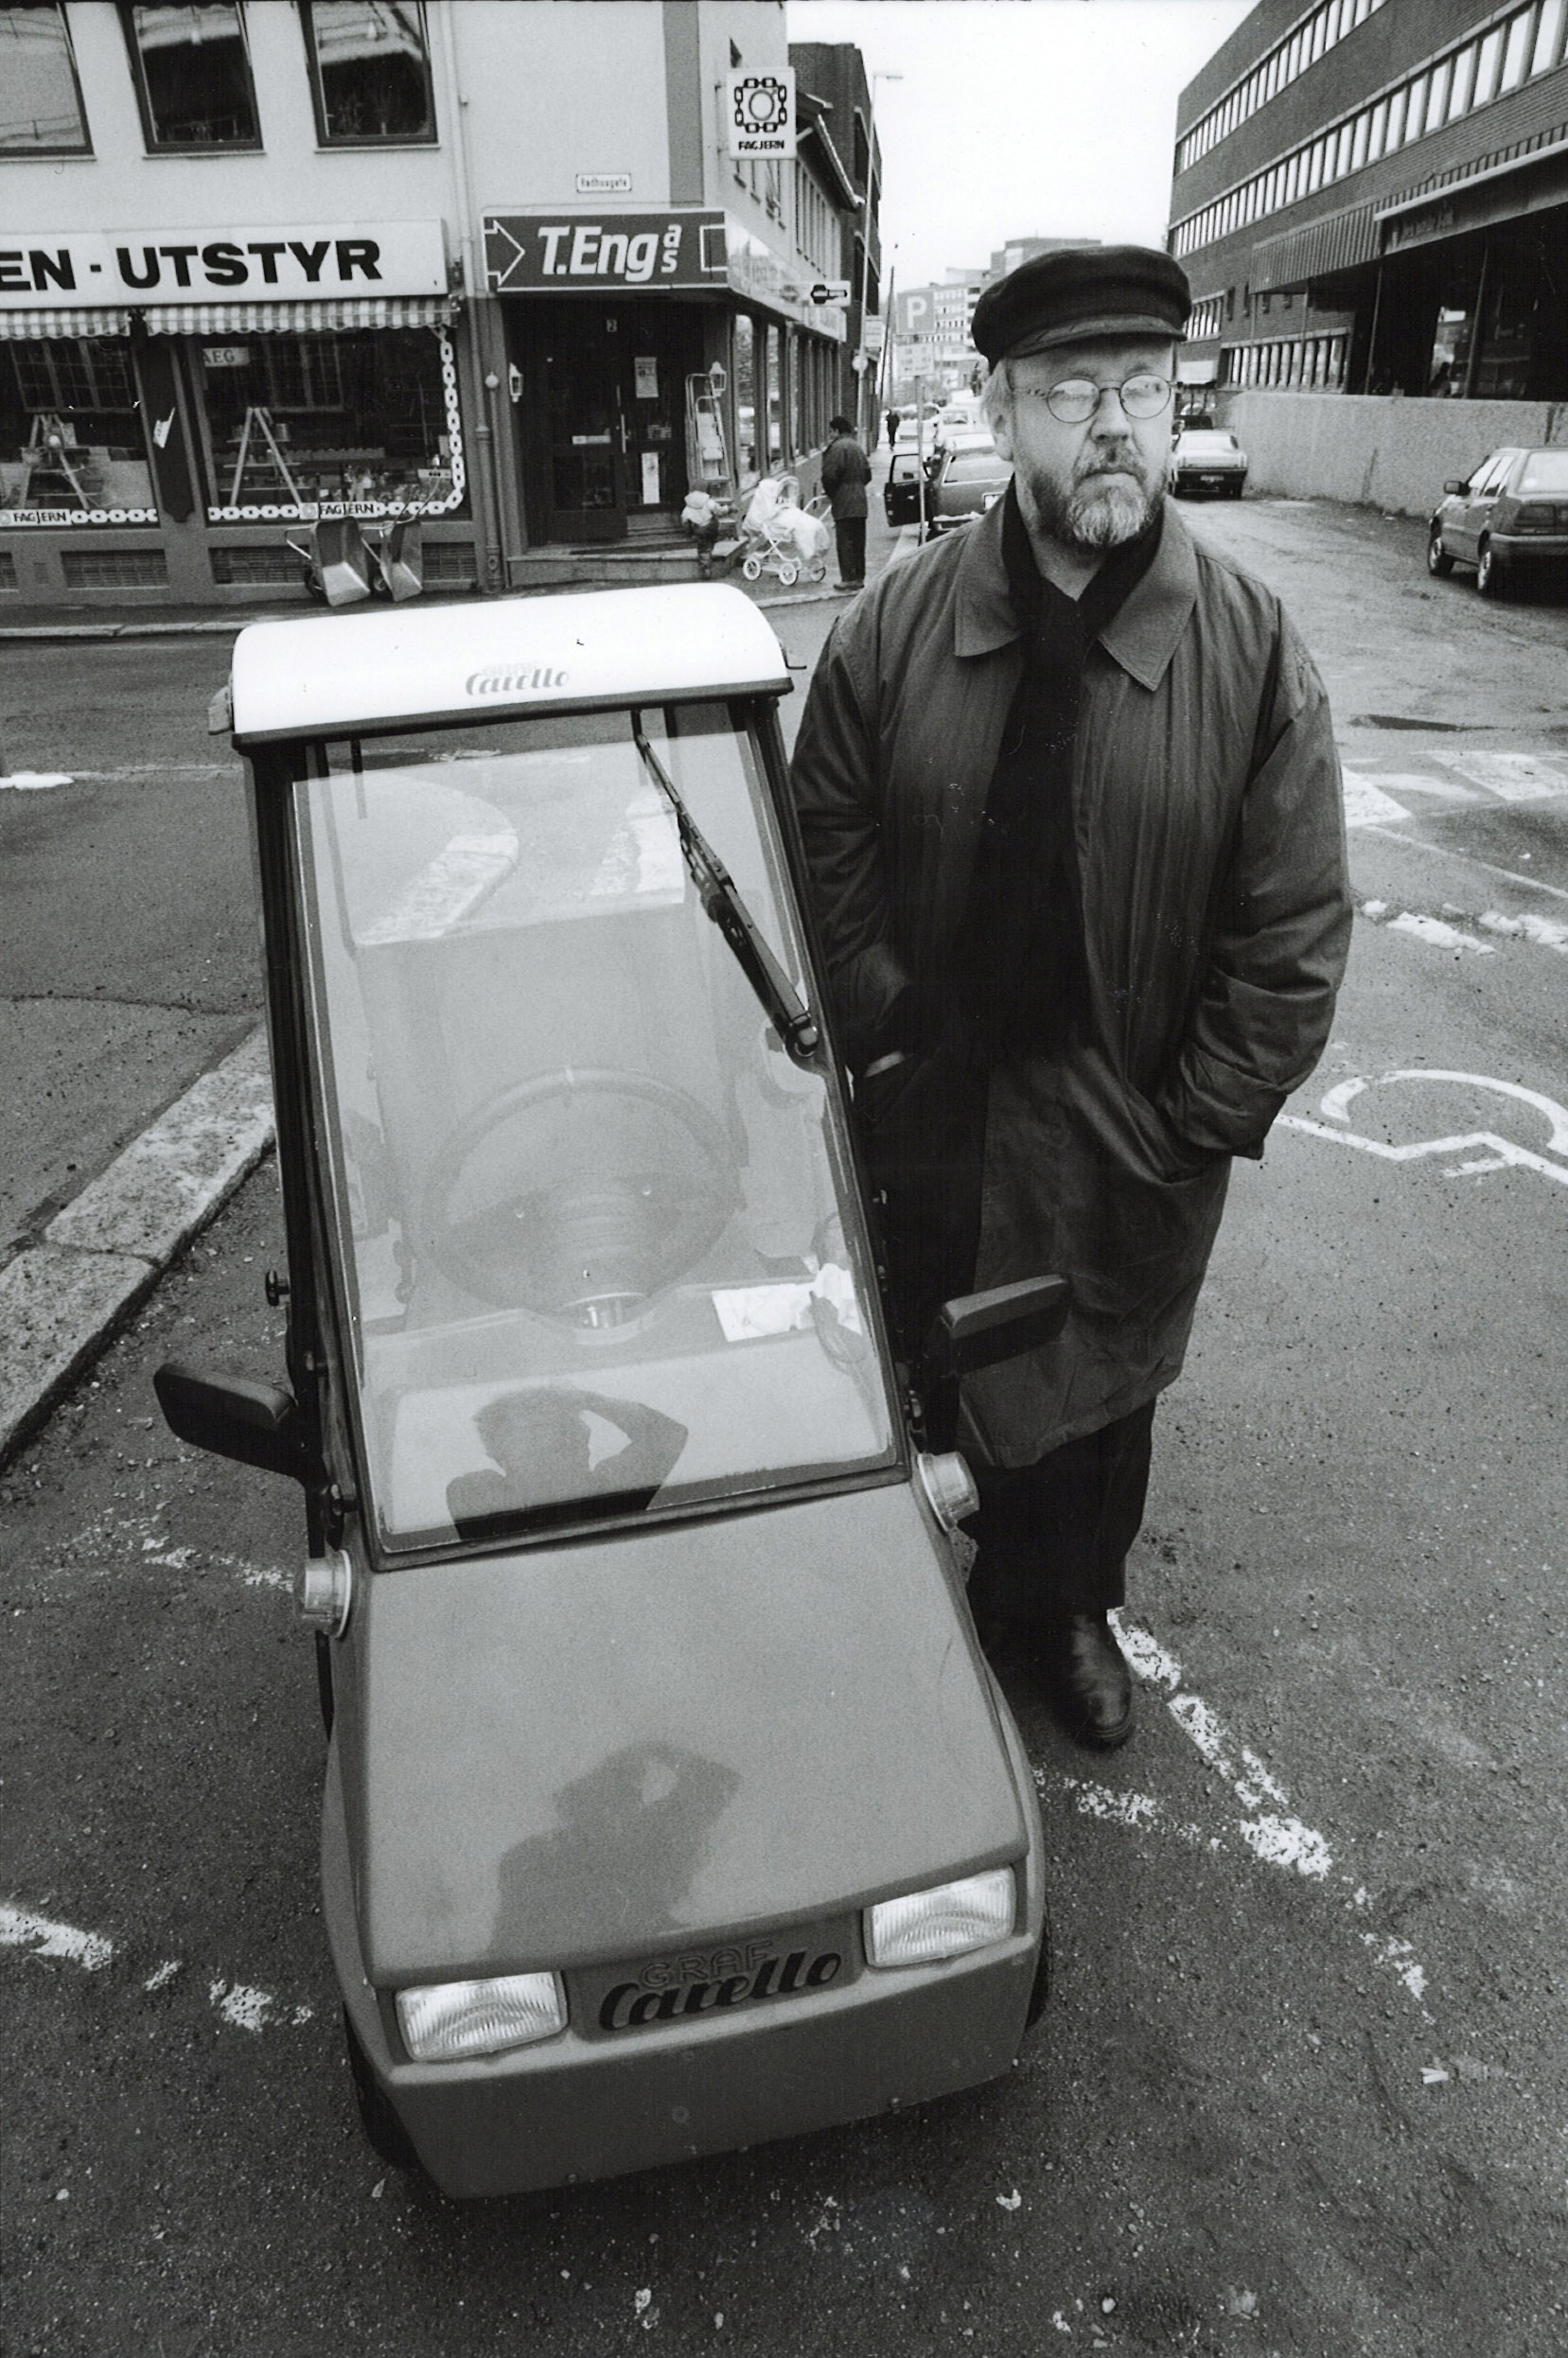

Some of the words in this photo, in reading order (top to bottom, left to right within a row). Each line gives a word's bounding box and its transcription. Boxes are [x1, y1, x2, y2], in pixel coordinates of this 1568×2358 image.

[738, 140, 784, 150] FAGJERN
[0, 250, 77, 291] EN
[115, 239, 383, 290] UTSTYR
[537, 225, 660, 282] T.Eng
[907, 295, 927, 329] P
[641, 1942, 774, 1988] GRAF
[598, 1951, 842, 2031] Carello
